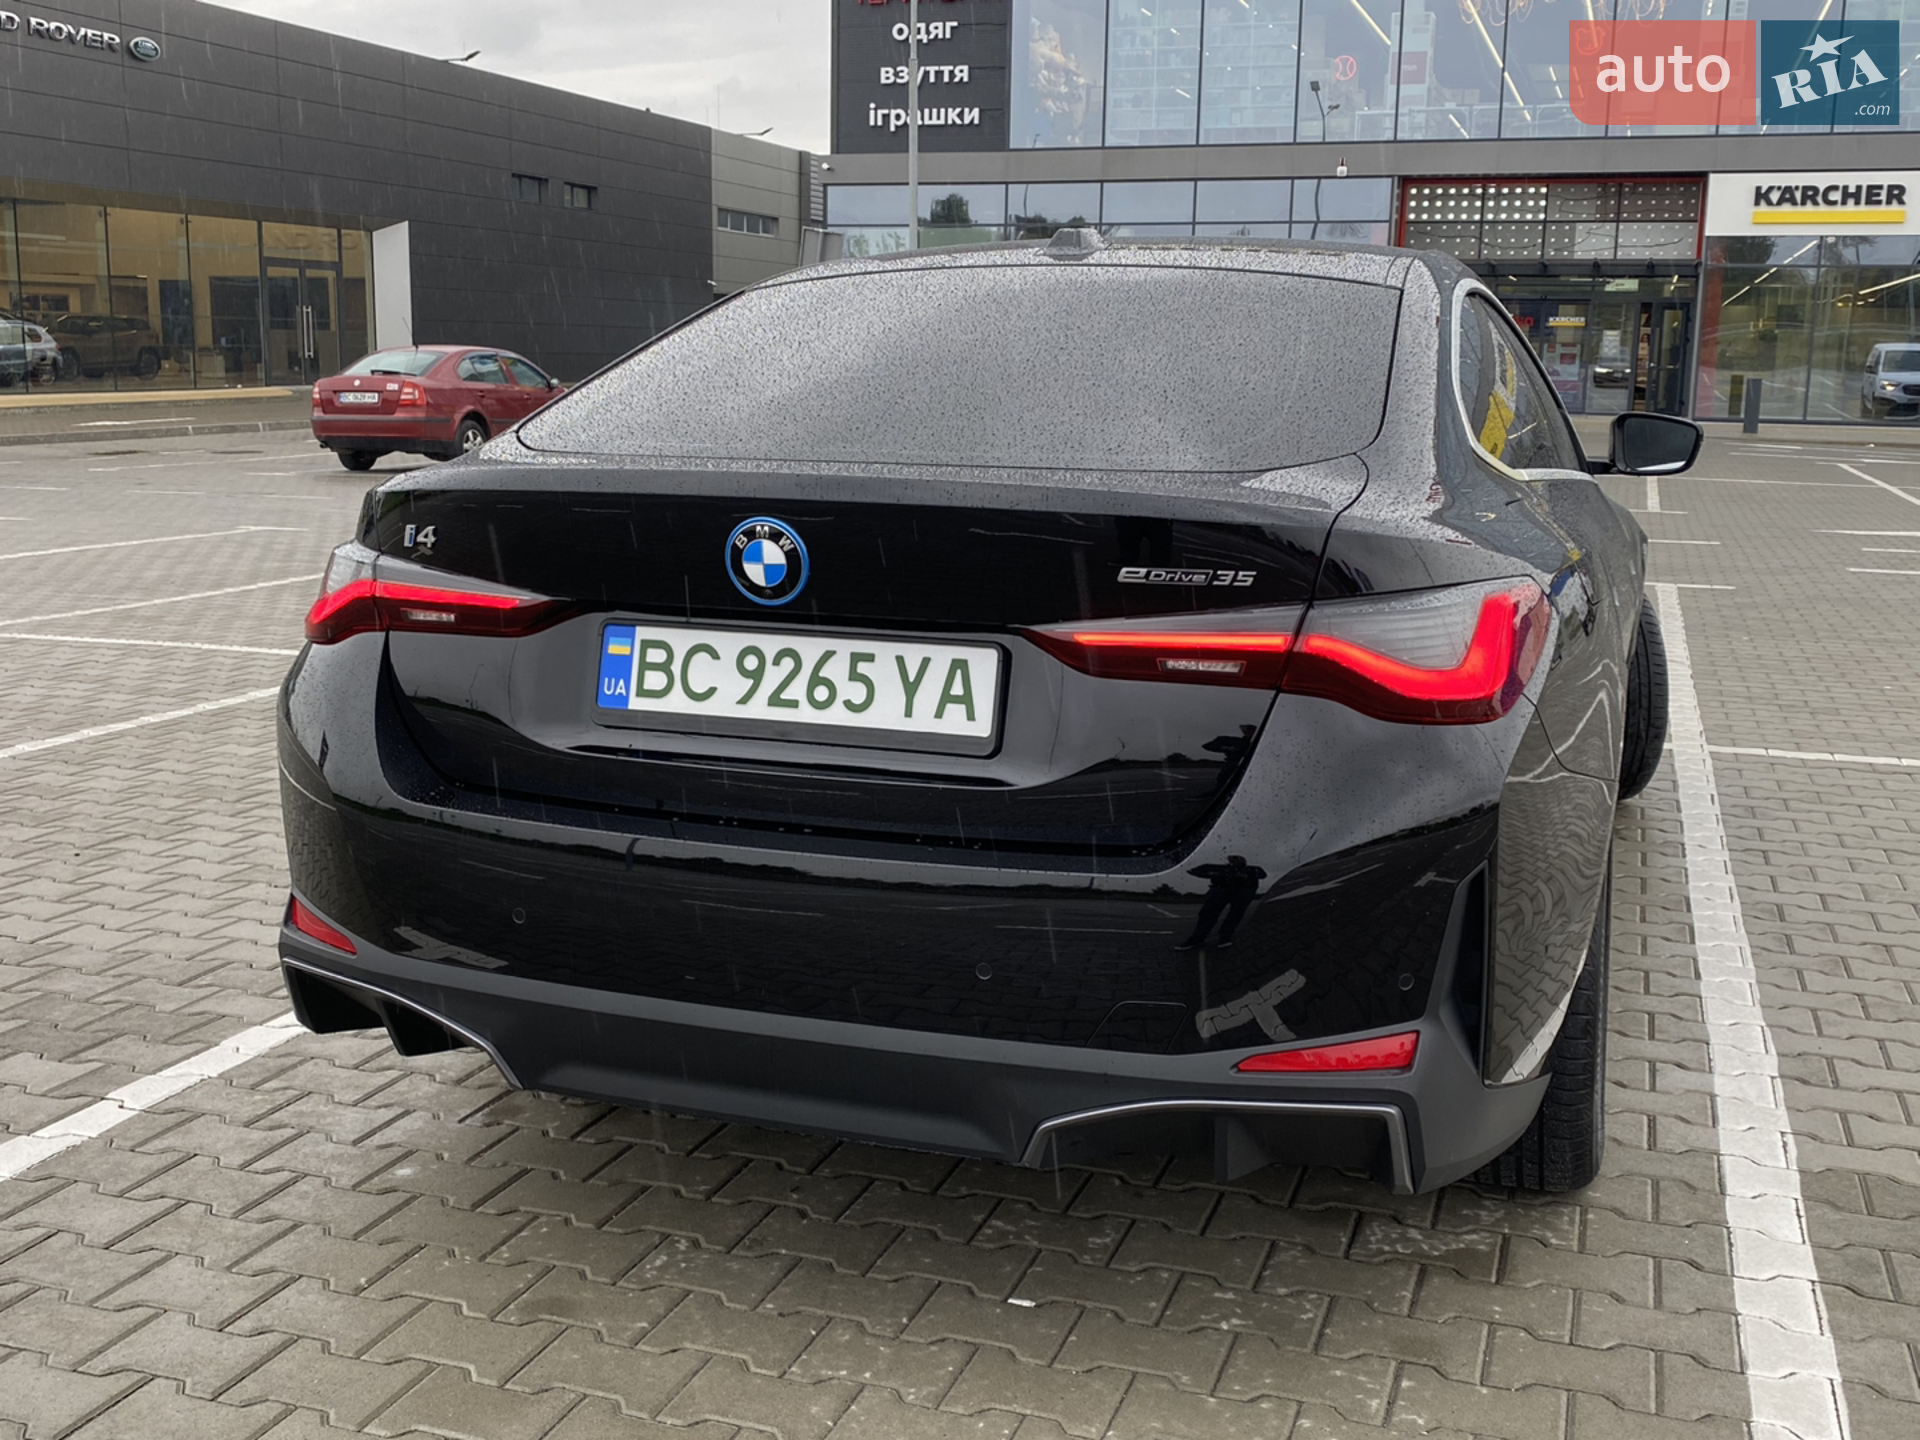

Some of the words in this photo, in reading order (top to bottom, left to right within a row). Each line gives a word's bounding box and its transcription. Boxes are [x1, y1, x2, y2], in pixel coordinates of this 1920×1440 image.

[28, 16, 120, 52] ROVER
[892, 21, 958, 44] одяг
[1753, 183, 1907, 207] KÄRCHER
[404, 524, 437, 548] i4
[735, 525, 795, 552] BMW
[603, 677, 627, 697] UA
[635, 639, 721, 702] BC
[735, 645, 876, 713] 9265
[894, 654, 976, 722] YA
